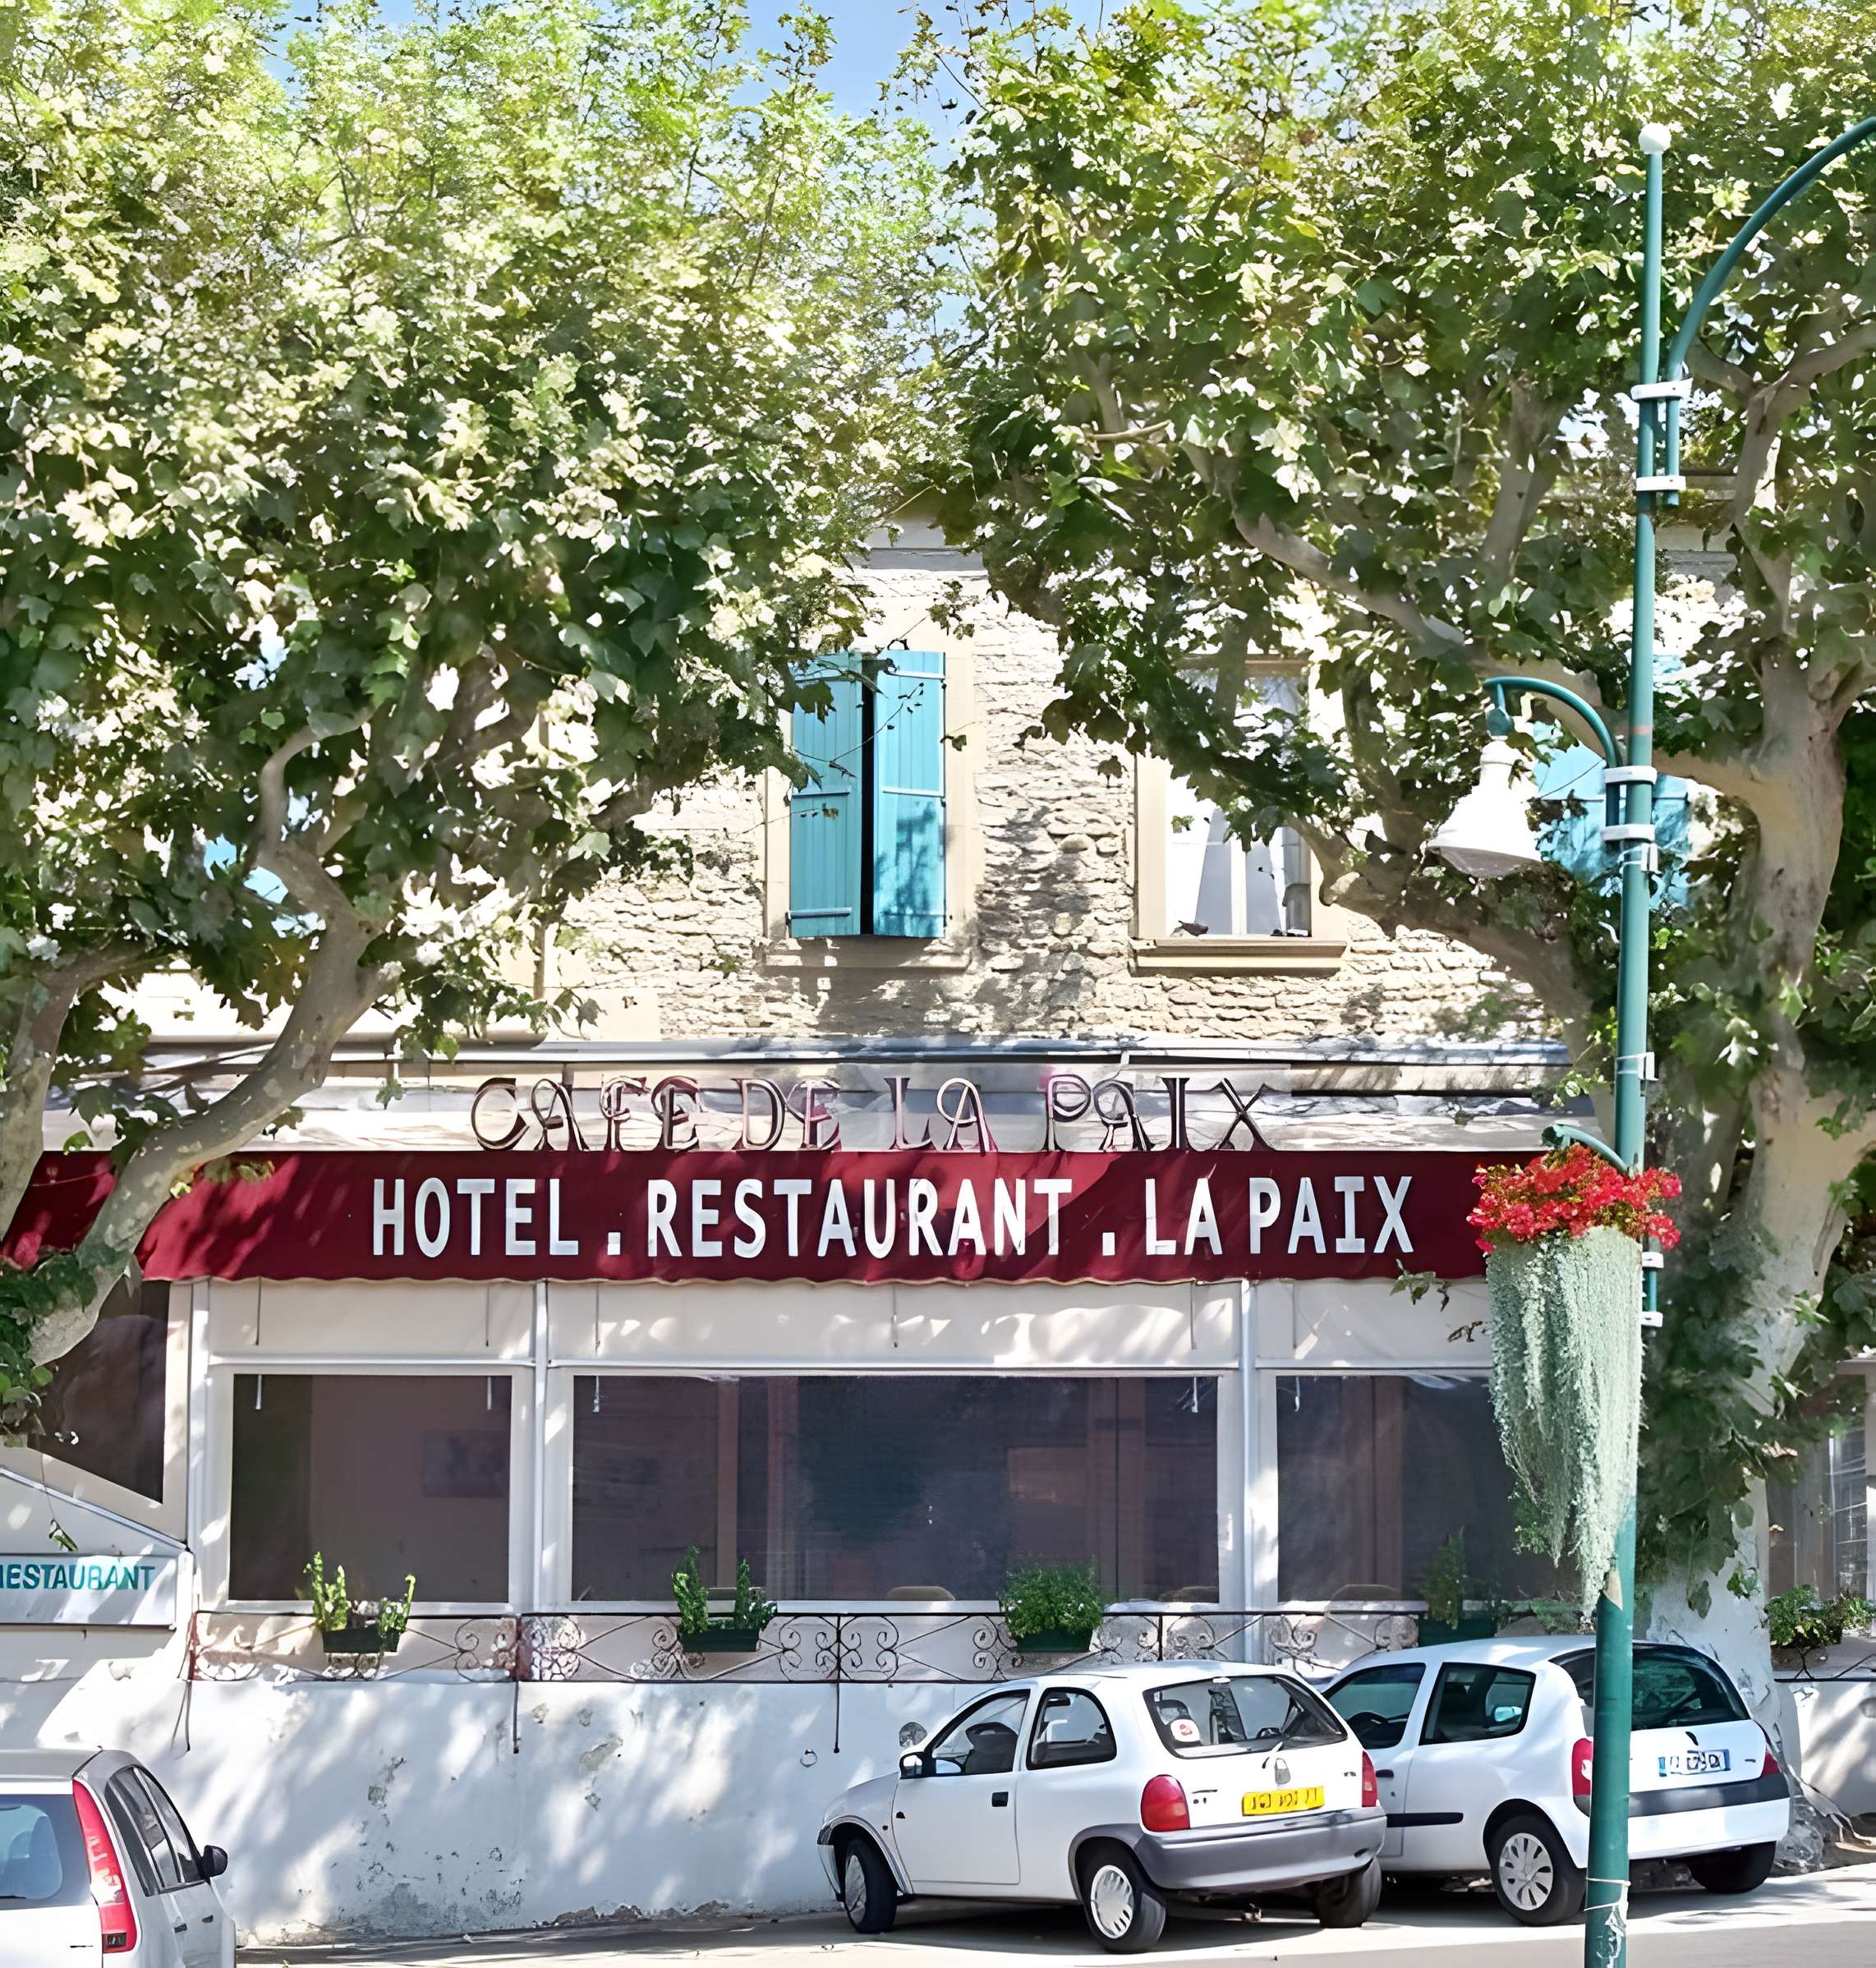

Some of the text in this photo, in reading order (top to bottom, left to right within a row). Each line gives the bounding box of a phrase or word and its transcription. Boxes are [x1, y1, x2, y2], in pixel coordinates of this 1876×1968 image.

[470, 1073, 1278, 1152] CAFE DE LA PAIX
[372, 1177, 580, 1258] HOTEL
[646, 1177, 1074, 1259] RESTAURANT
[1144, 1177, 1224, 1257] LA
[1248, 1175, 1414, 1255] PAIX
[0, 1563, 156, 1590] ESTAURANT
